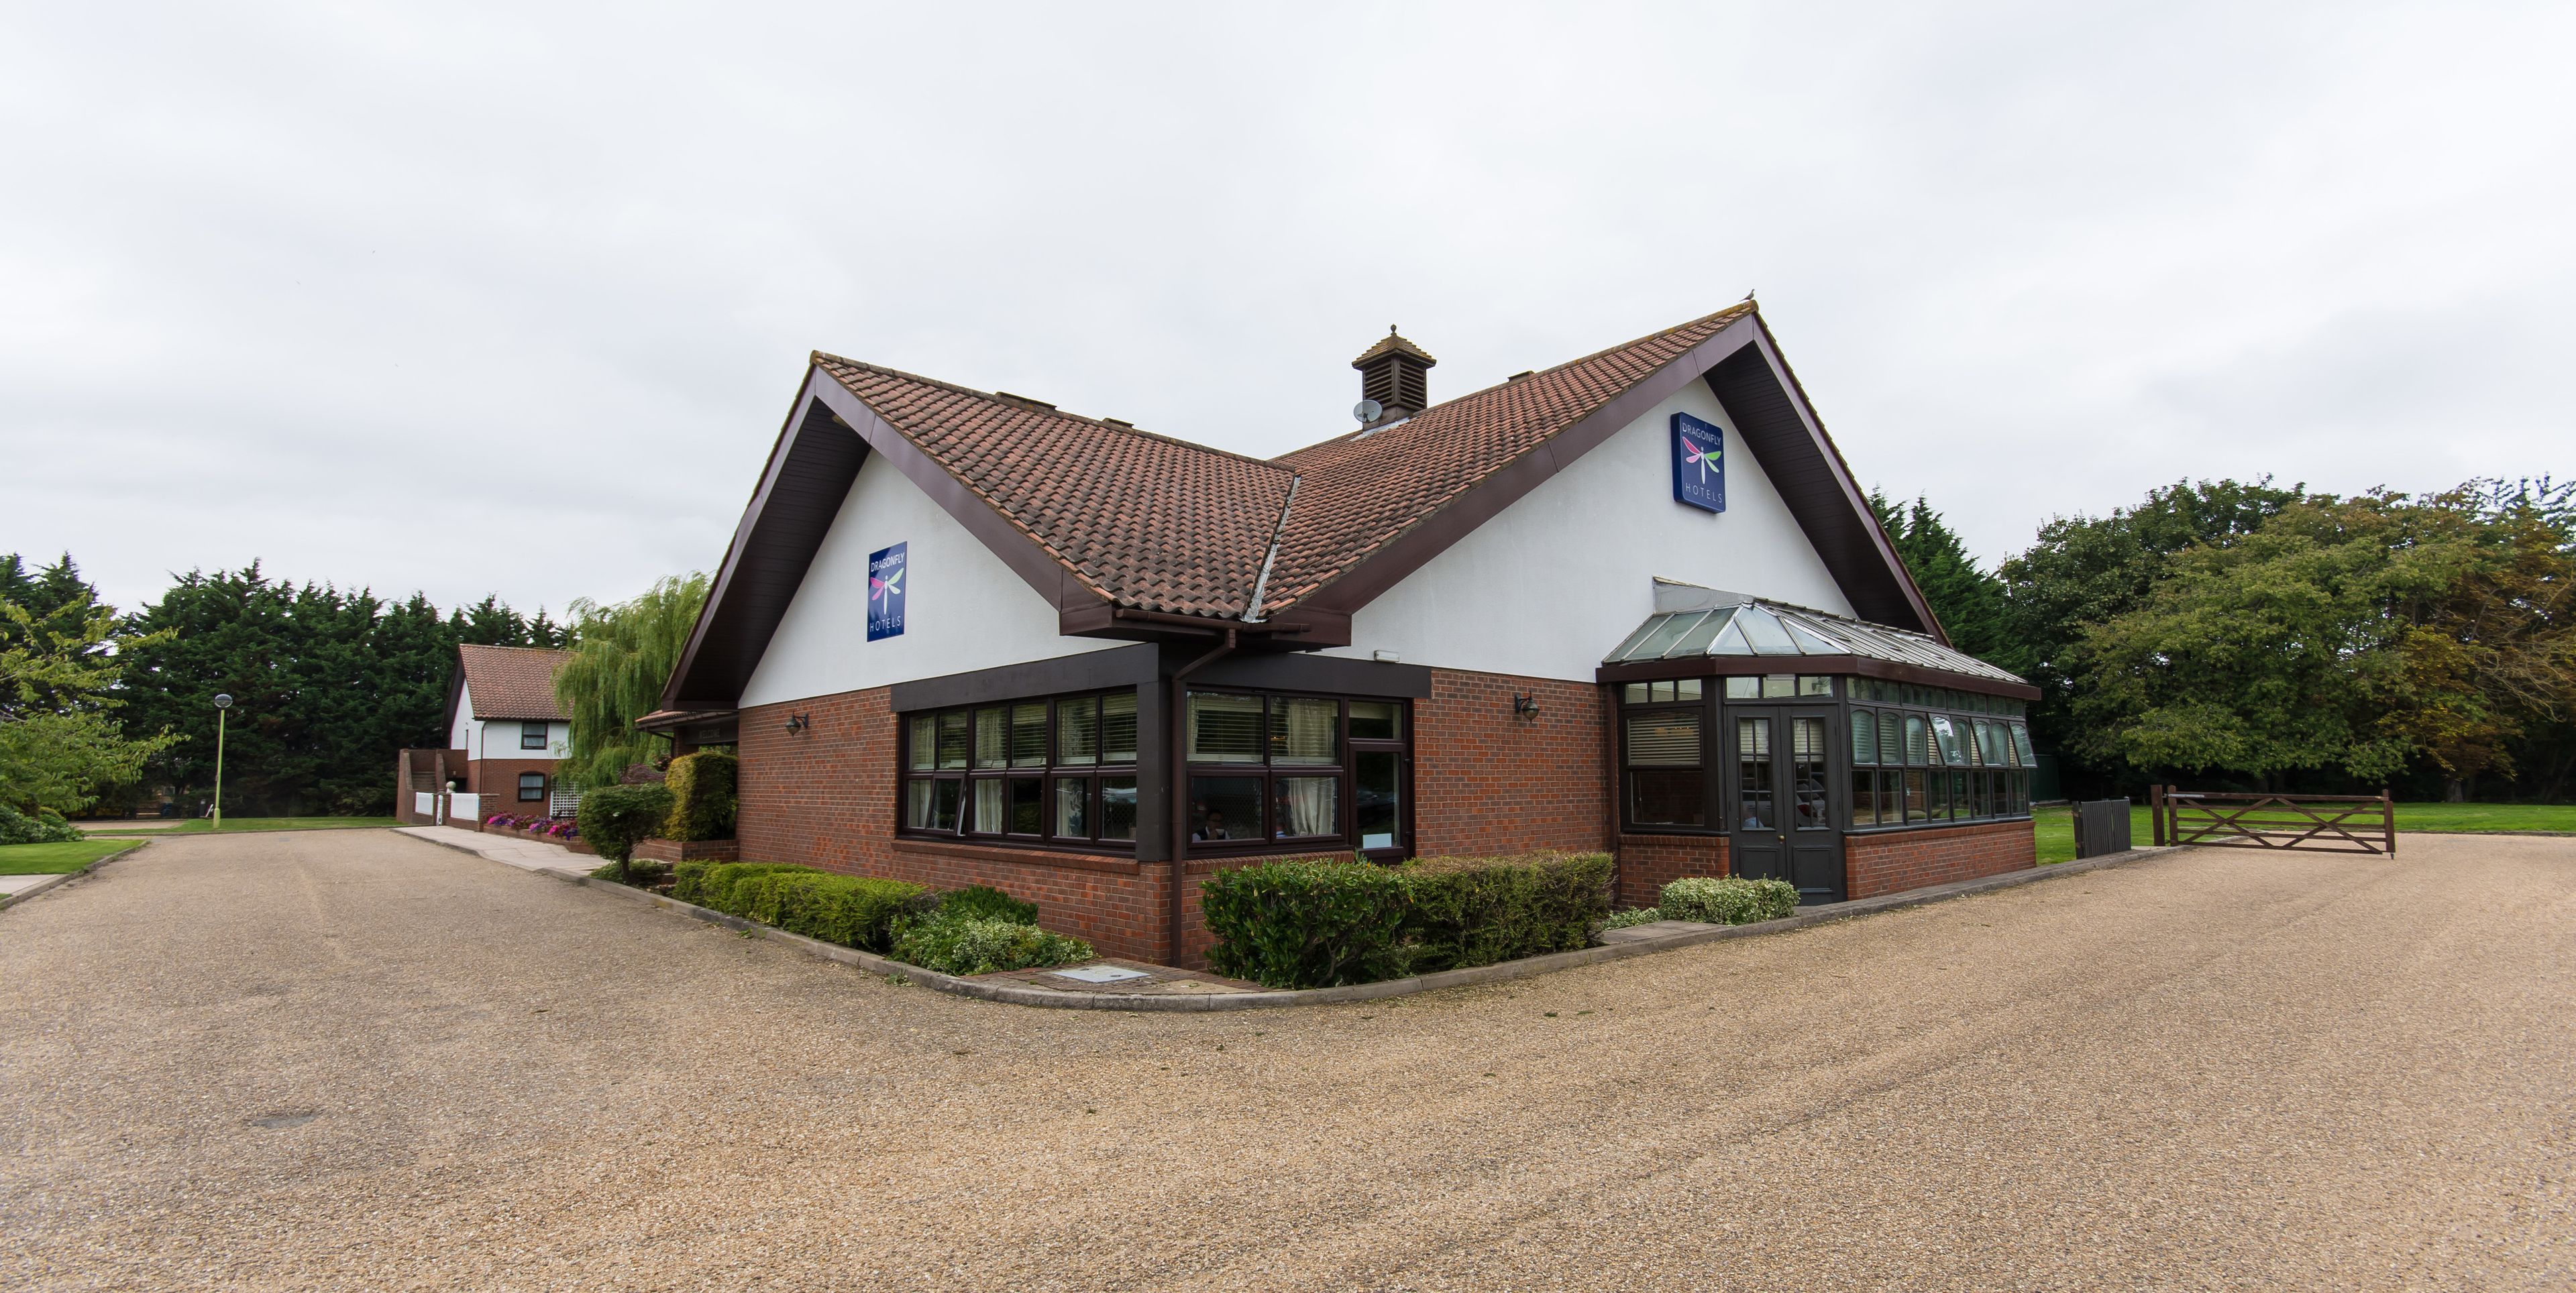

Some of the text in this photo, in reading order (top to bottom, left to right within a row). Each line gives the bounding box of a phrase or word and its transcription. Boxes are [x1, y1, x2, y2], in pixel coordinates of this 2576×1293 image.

[1682, 423, 1721, 446] DRAGONFLY
[1686, 482, 1722, 504] HOTELS
[871, 552, 905, 572] DRAGONFLY
[869, 616, 901, 632] HOTELS
